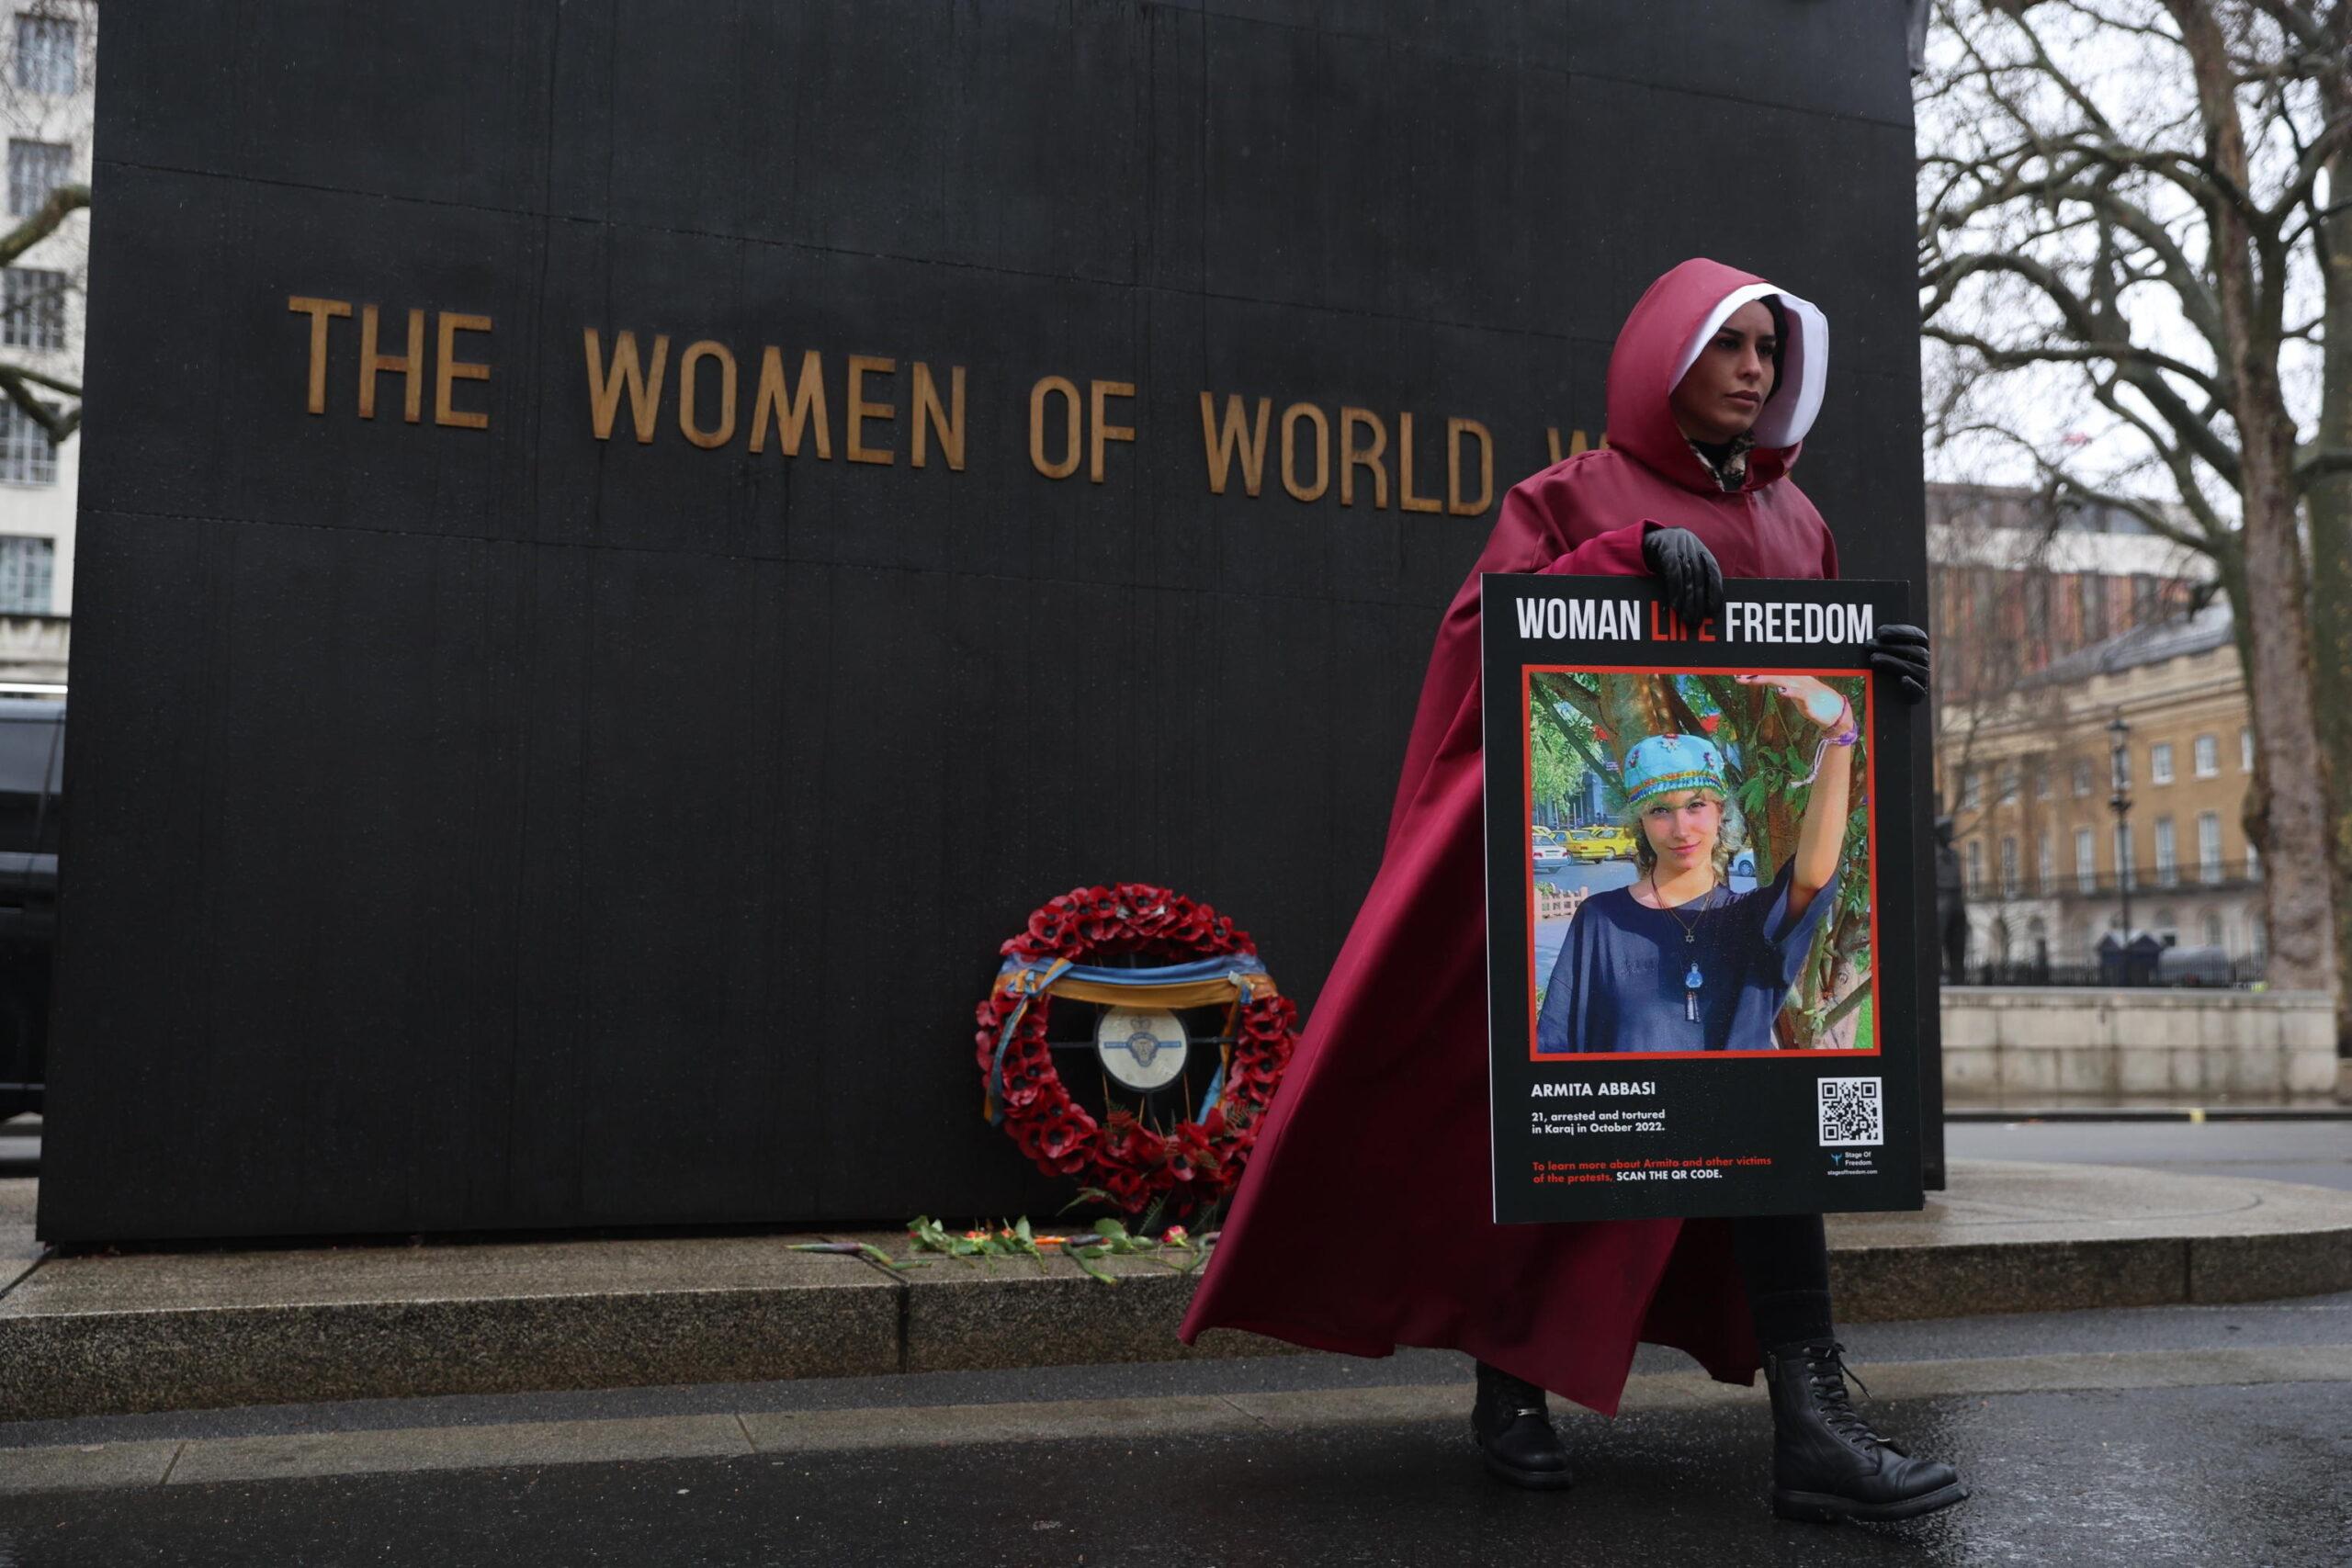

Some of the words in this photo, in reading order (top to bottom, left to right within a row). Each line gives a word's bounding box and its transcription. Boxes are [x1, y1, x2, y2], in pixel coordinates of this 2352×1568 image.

[288, 296, 492, 428] THE
[583, 328, 967, 471] WOMEN
[1029, 376, 1136, 482] OF
[1200, 391, 1493, 515] WORLD
[1516, 597, 1640, 641] WOMAN
[1725, 602, 1873, 643] FREEDOM
[1531, 1083, 1593, 1097] ARMITA
[1598, 1082, 1656, 1096] ABBASI
[1532, 1112, 1547, 1122] 21,
[1551, 1111, 1595, 1122] arrested
[1599, 1111, 1619, 1120] and
[1622, 1109, 1665, 1120] tortured
[1532, 1124, 1542, 1134] in
[1544, 1123, 1574, 1135] Karaj
[1577, 1123, 1587, 1133] in
[1590, 1122, 1632, 1133] October
[1635, 1122, 1665, 1132] 2022.
[1532, 1161, 1544, 1171] To
[1548, 1161, 1576, 1170] learn
[1610, 1158, 1640, 1168] about
[1682, 1157, 1702, 1167] and
[1705, 1157, 1733, 1167] other
[1736, 1156, 1771, 1166] victims
[1533, 1174, 1544, 1183] of
[1547, 1173, 1564, 1182] the
[1567, 1173, 1612, 1185] protests,
[1616, 1171, 1645, 1180] SCAN
[1649, 1170, 1668, 1179] THE
[1671, 1170, 1687, 1179] QR
[1690, 1169, 1723, 1179] CODE.
